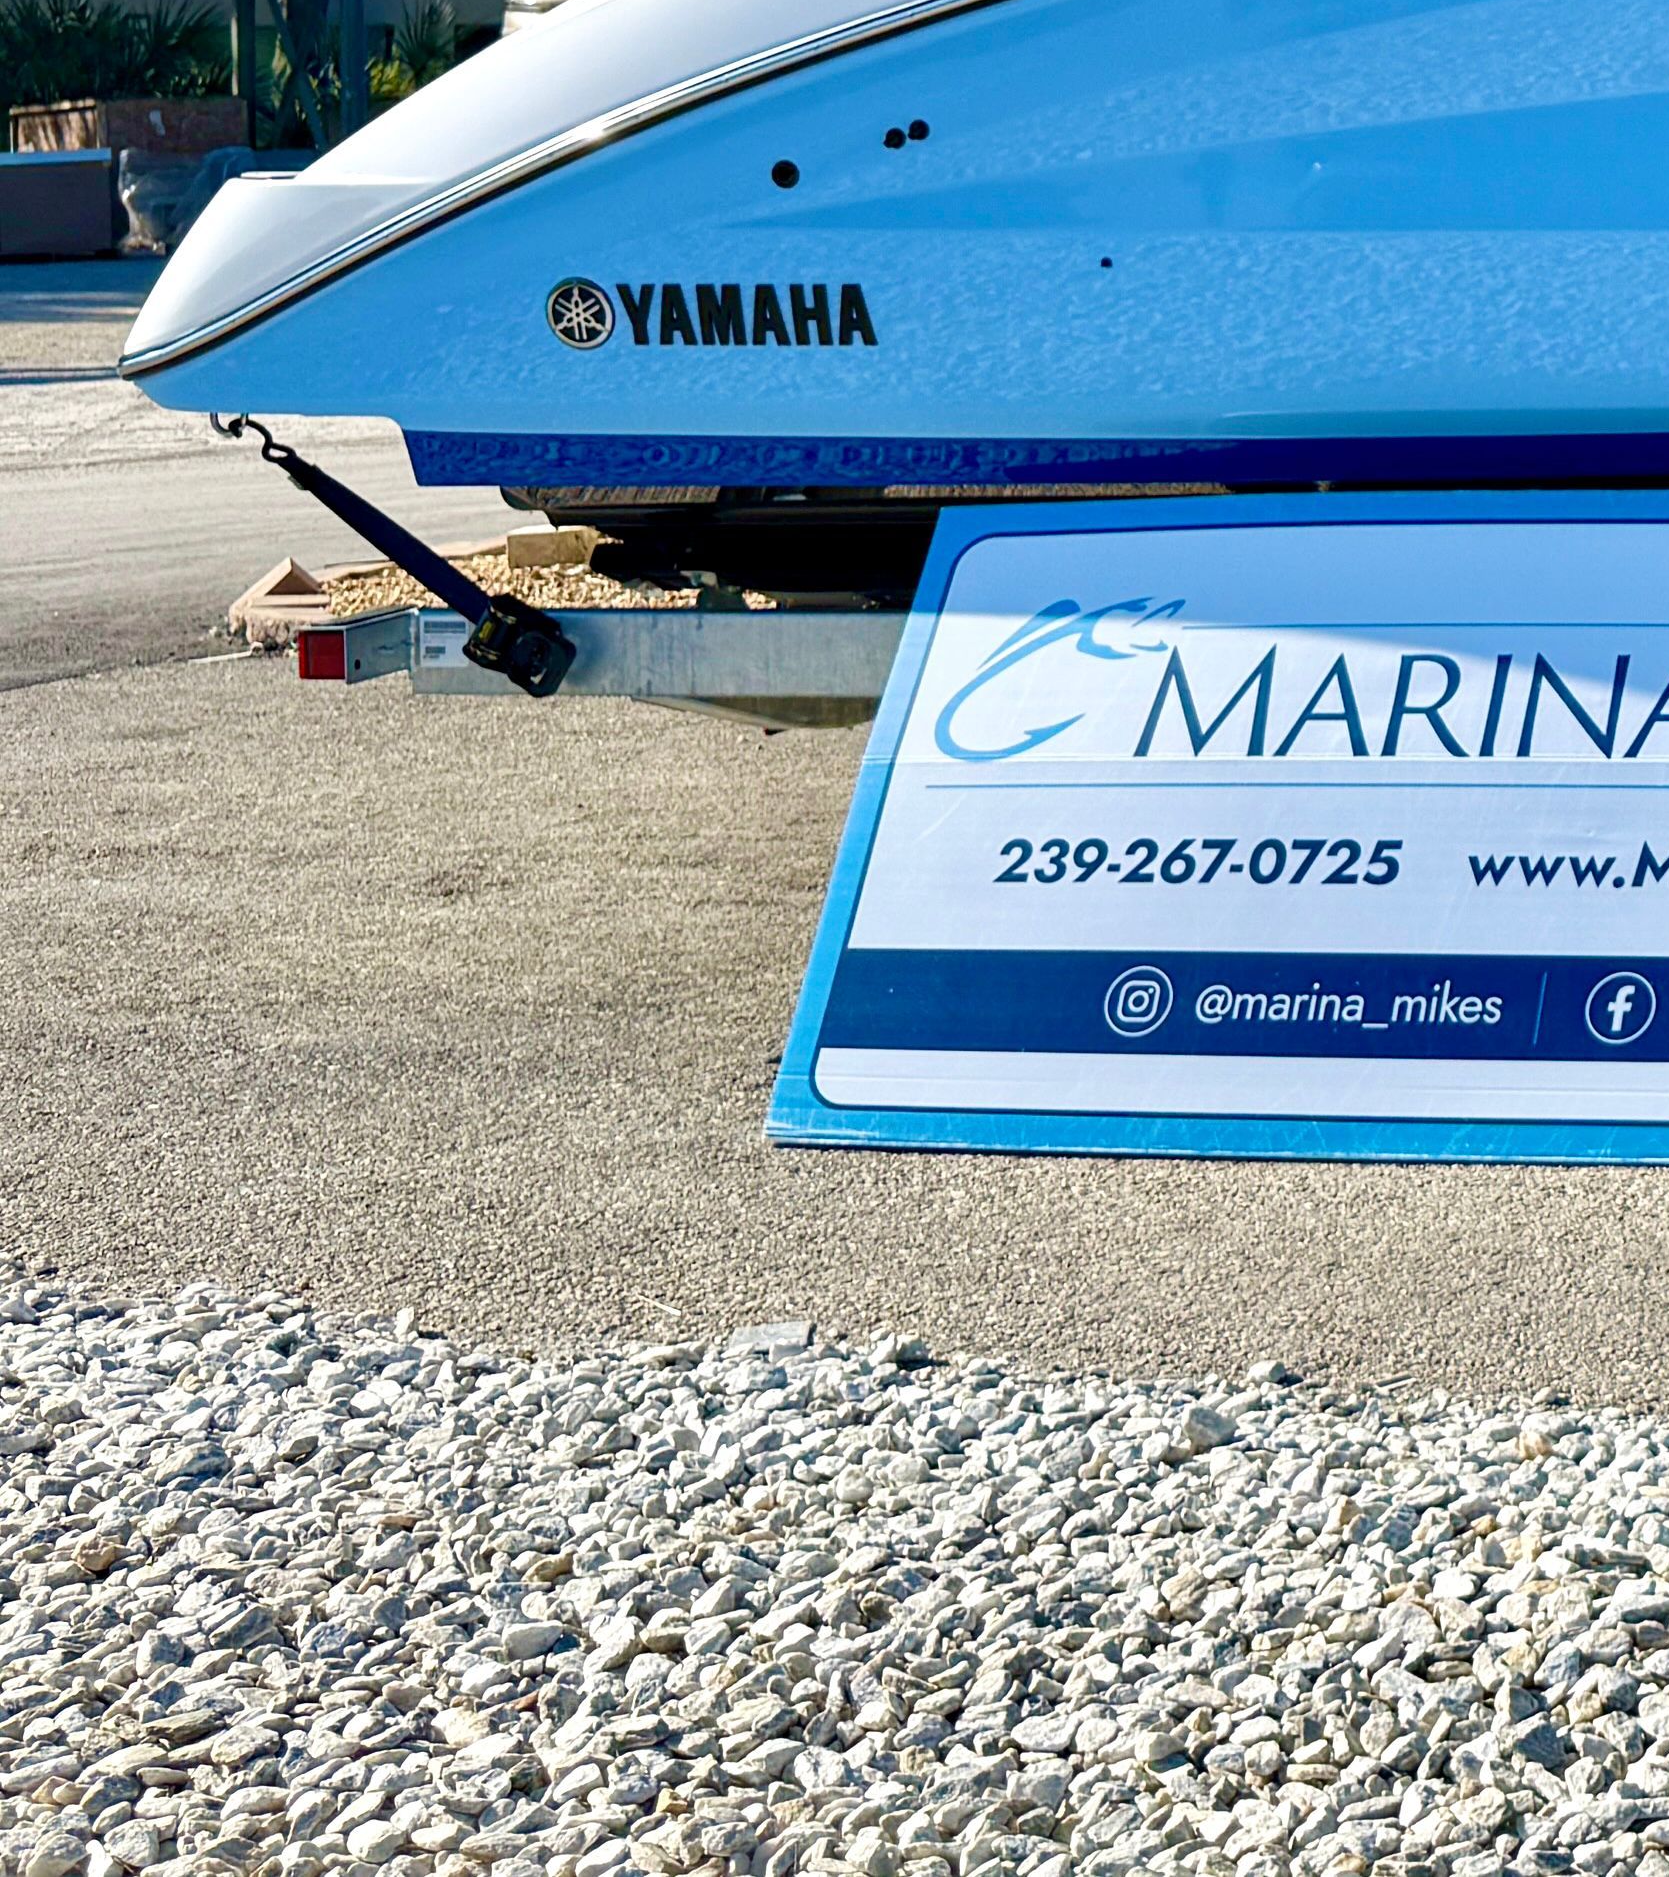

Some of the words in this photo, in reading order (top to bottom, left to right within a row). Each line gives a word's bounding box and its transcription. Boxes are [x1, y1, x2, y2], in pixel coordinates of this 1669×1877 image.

[615, 283, 879, 346] YAMAHA
[992, 837, 1404, 885] 239-267-0725
[1194, 979, 1504, 1029] @marina_mikes
